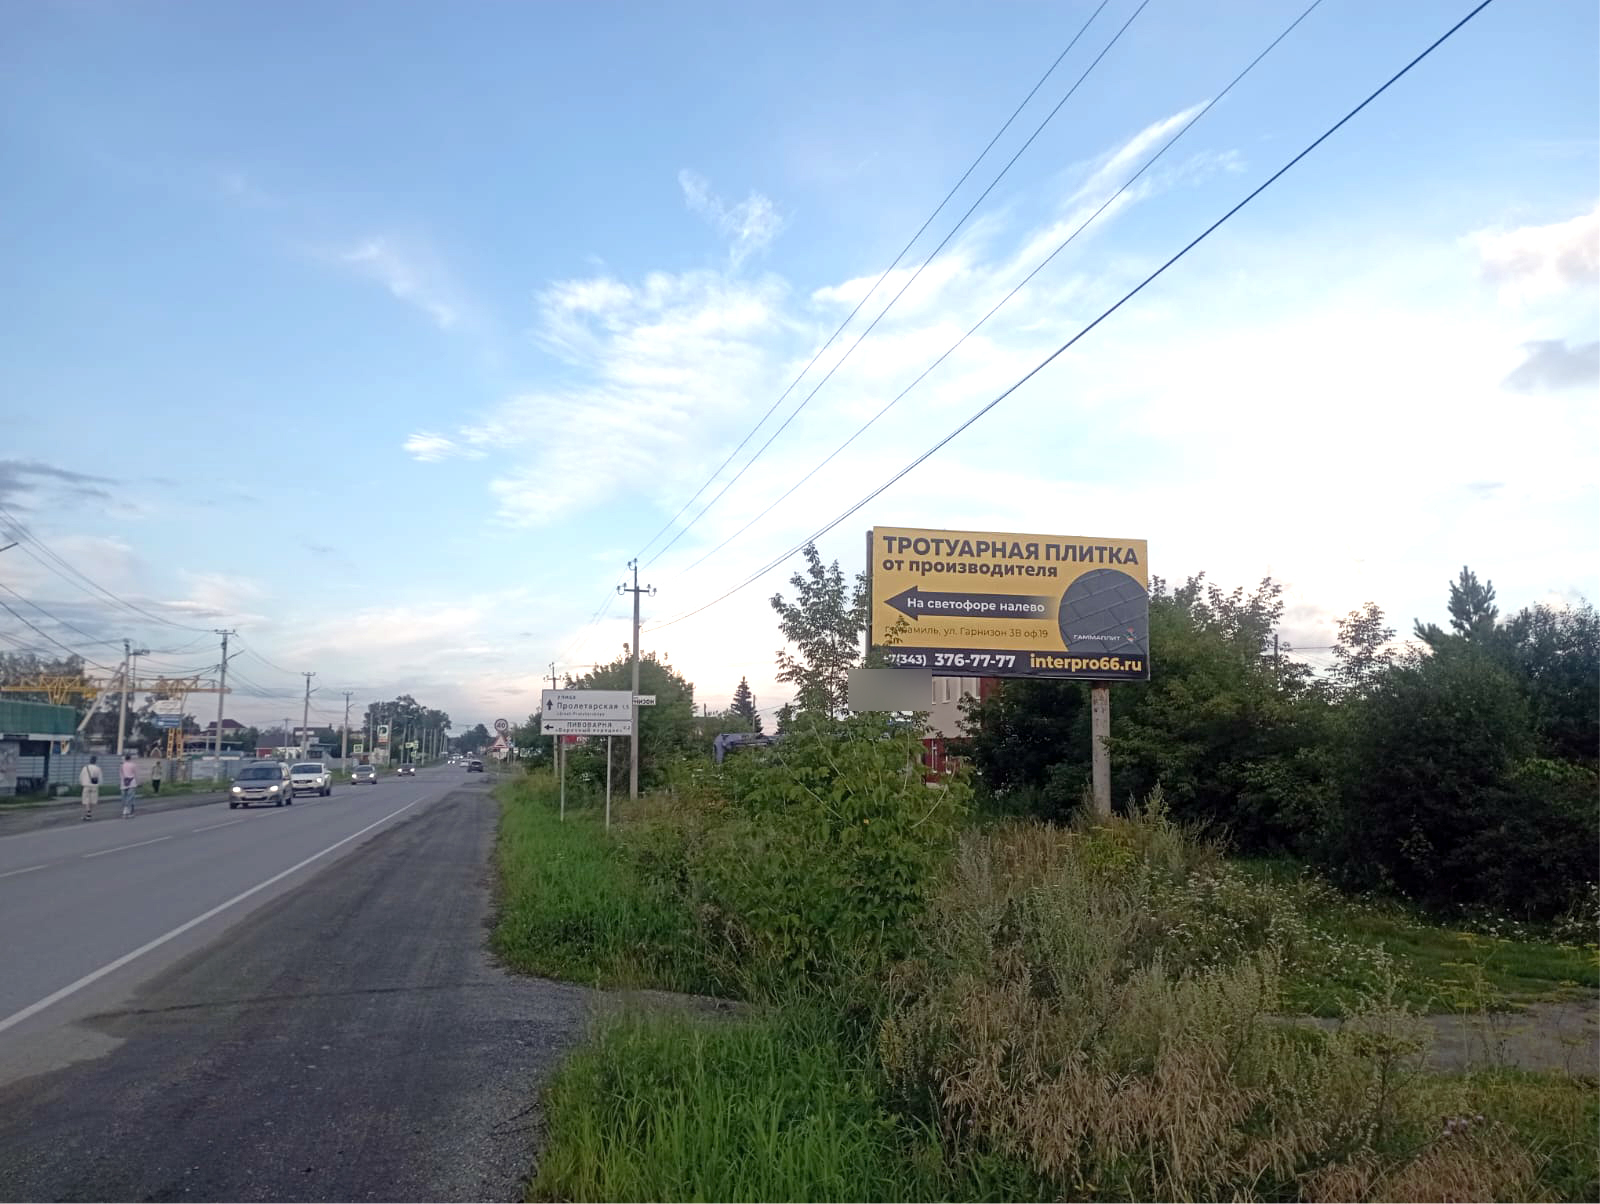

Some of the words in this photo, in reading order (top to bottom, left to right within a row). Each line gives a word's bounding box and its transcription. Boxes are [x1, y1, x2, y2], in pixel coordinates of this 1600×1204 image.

[883, 535, 1039, 560] ТРОТУАРНАЯ
[1045, 544, 1139, 565] ПЛИТКА
[882, 560, 904, 571] от
[908, 560, 1058, 577] производителя
[907, 597, 924, 609] На
[927, 599, 997, 613] светофоре
[999, 602, 1045, 613] налево
[943, 627, 958, 636] ул.
[959, 627, 1007, 637] Гарнизон
[934, 653, 1016, 668] 376-77-77
[1030, 653, 1142, 673] interpro66.ru
[556, 702, 619, 711] Пролетарская
[566, 721, 613, 729] ПИВОВАРНЯ
